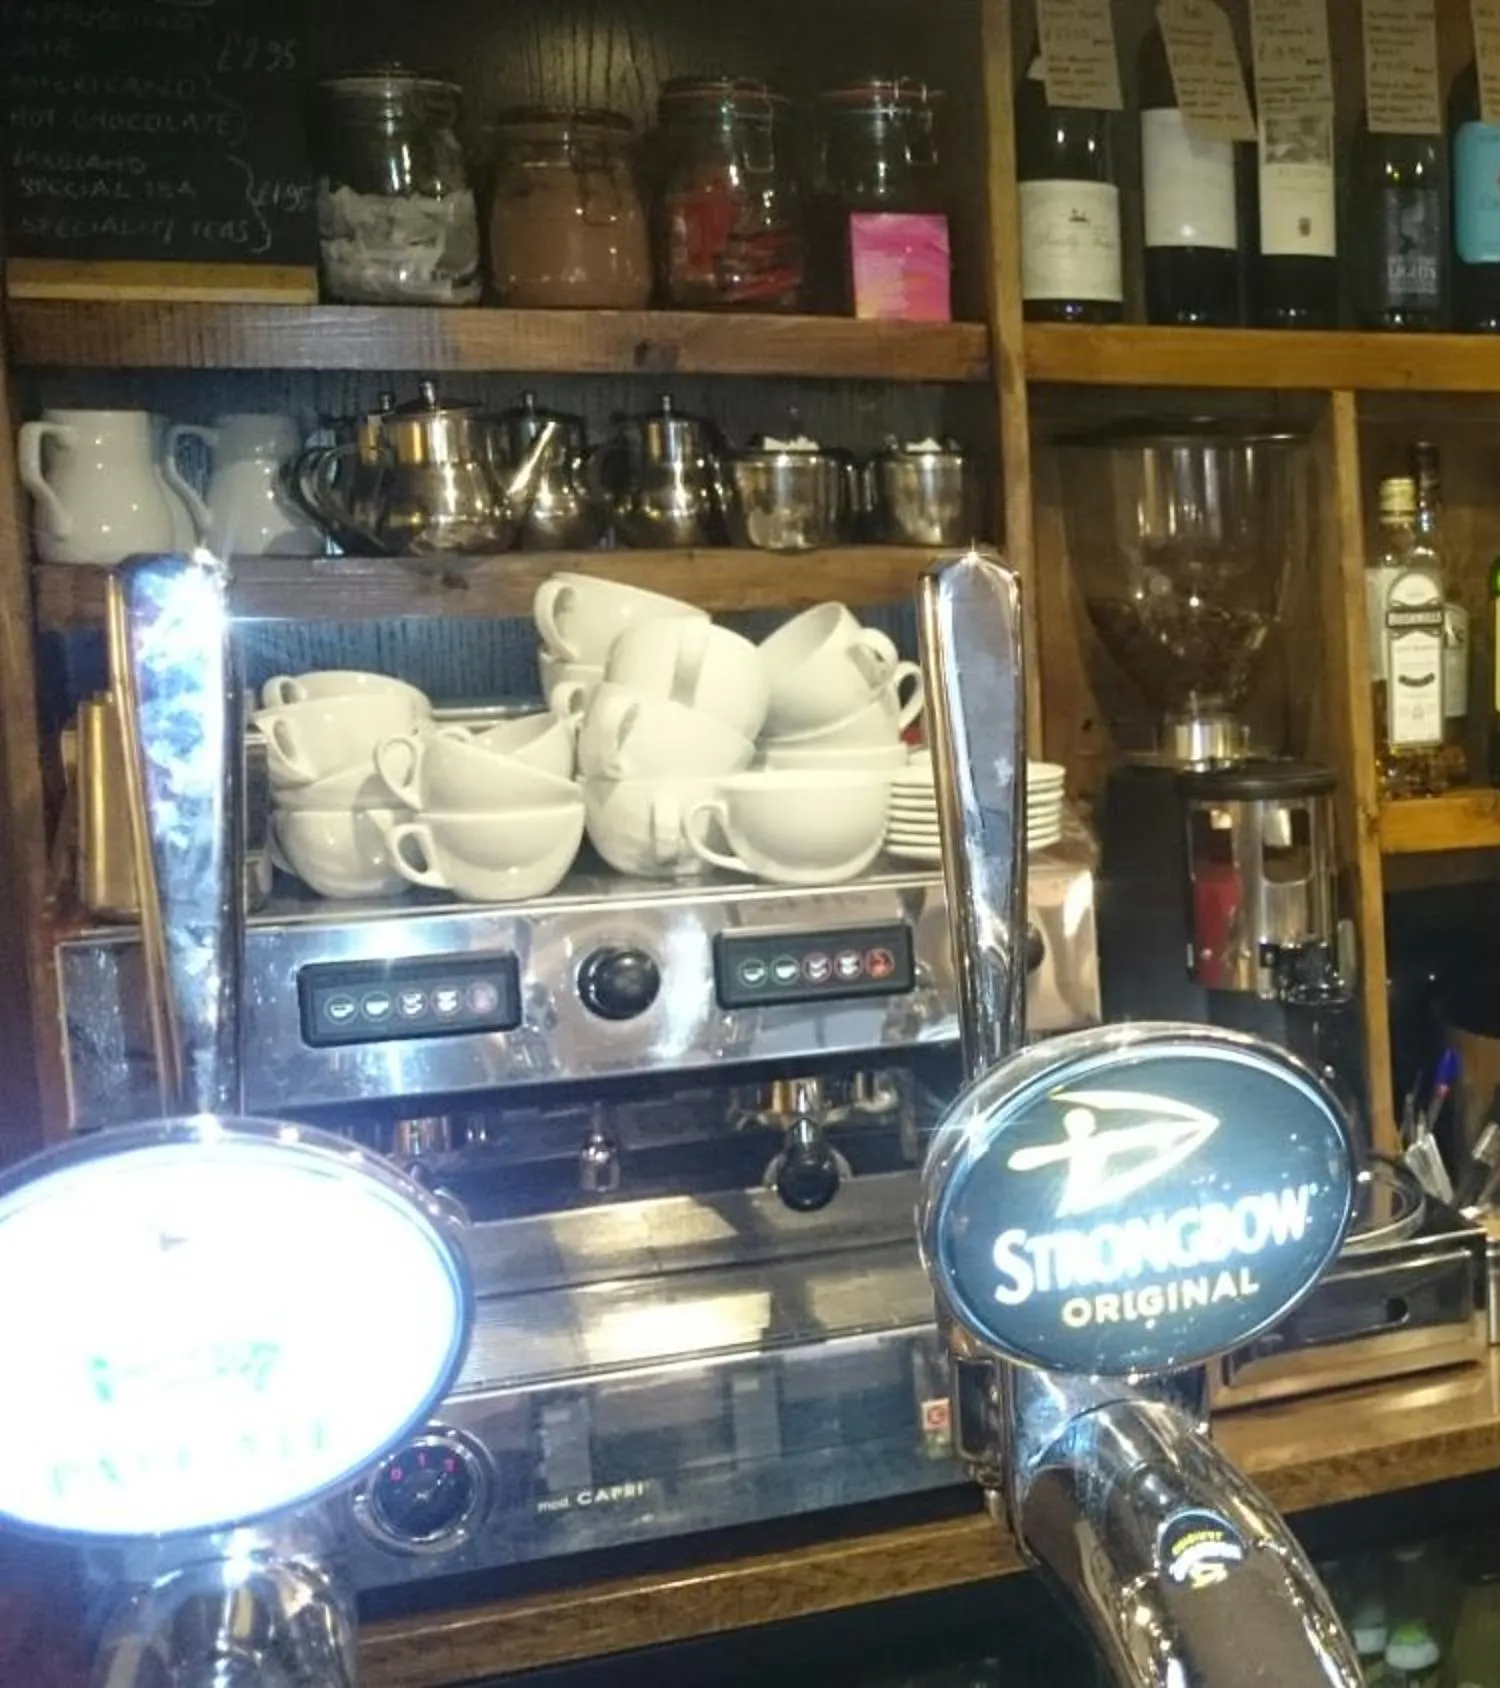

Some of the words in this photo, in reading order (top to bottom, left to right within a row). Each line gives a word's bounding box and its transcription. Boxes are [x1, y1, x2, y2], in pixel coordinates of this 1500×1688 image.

[9, 105, 56, 129] HOT
[71, 110, 232, 136] CHOCOLATE
[993, 1186, 1311, 1305] STRONGBOW
[1062, 1267, 1260, 1328] ORIGINAL
[577, 1480, 645, 1506] CAPRI
